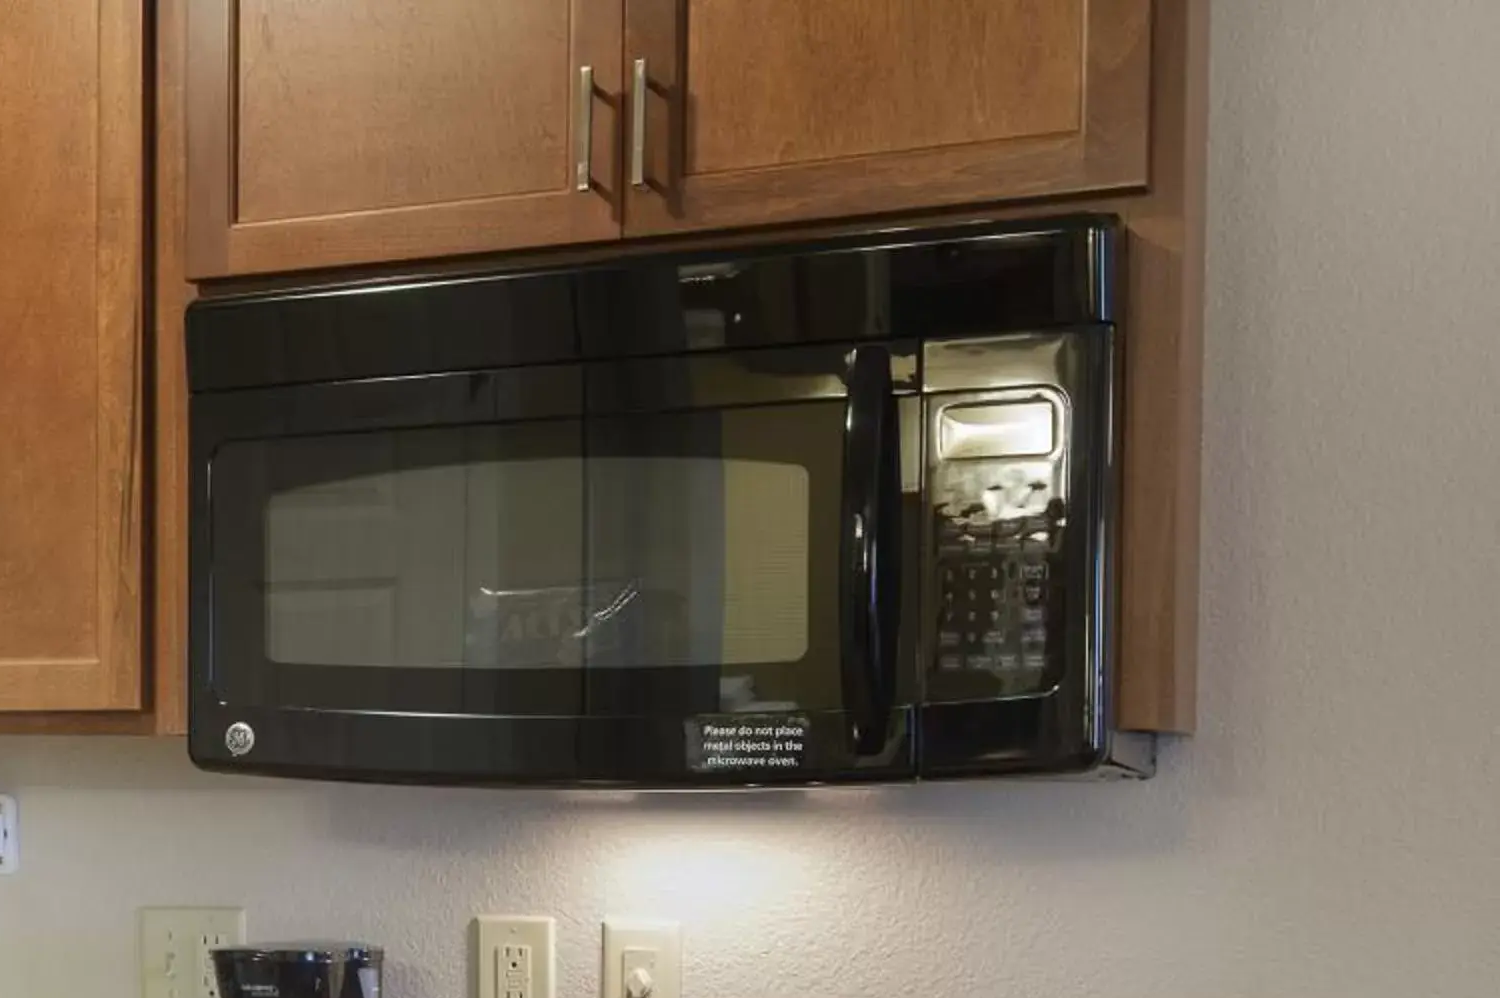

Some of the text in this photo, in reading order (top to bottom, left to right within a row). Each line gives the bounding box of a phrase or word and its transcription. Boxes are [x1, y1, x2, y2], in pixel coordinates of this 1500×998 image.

[703, 725, 803, 738] Please do not place
[703, 740, 803, 752] metal objects in the
[706, 755, 799, 767] microwave oven.
